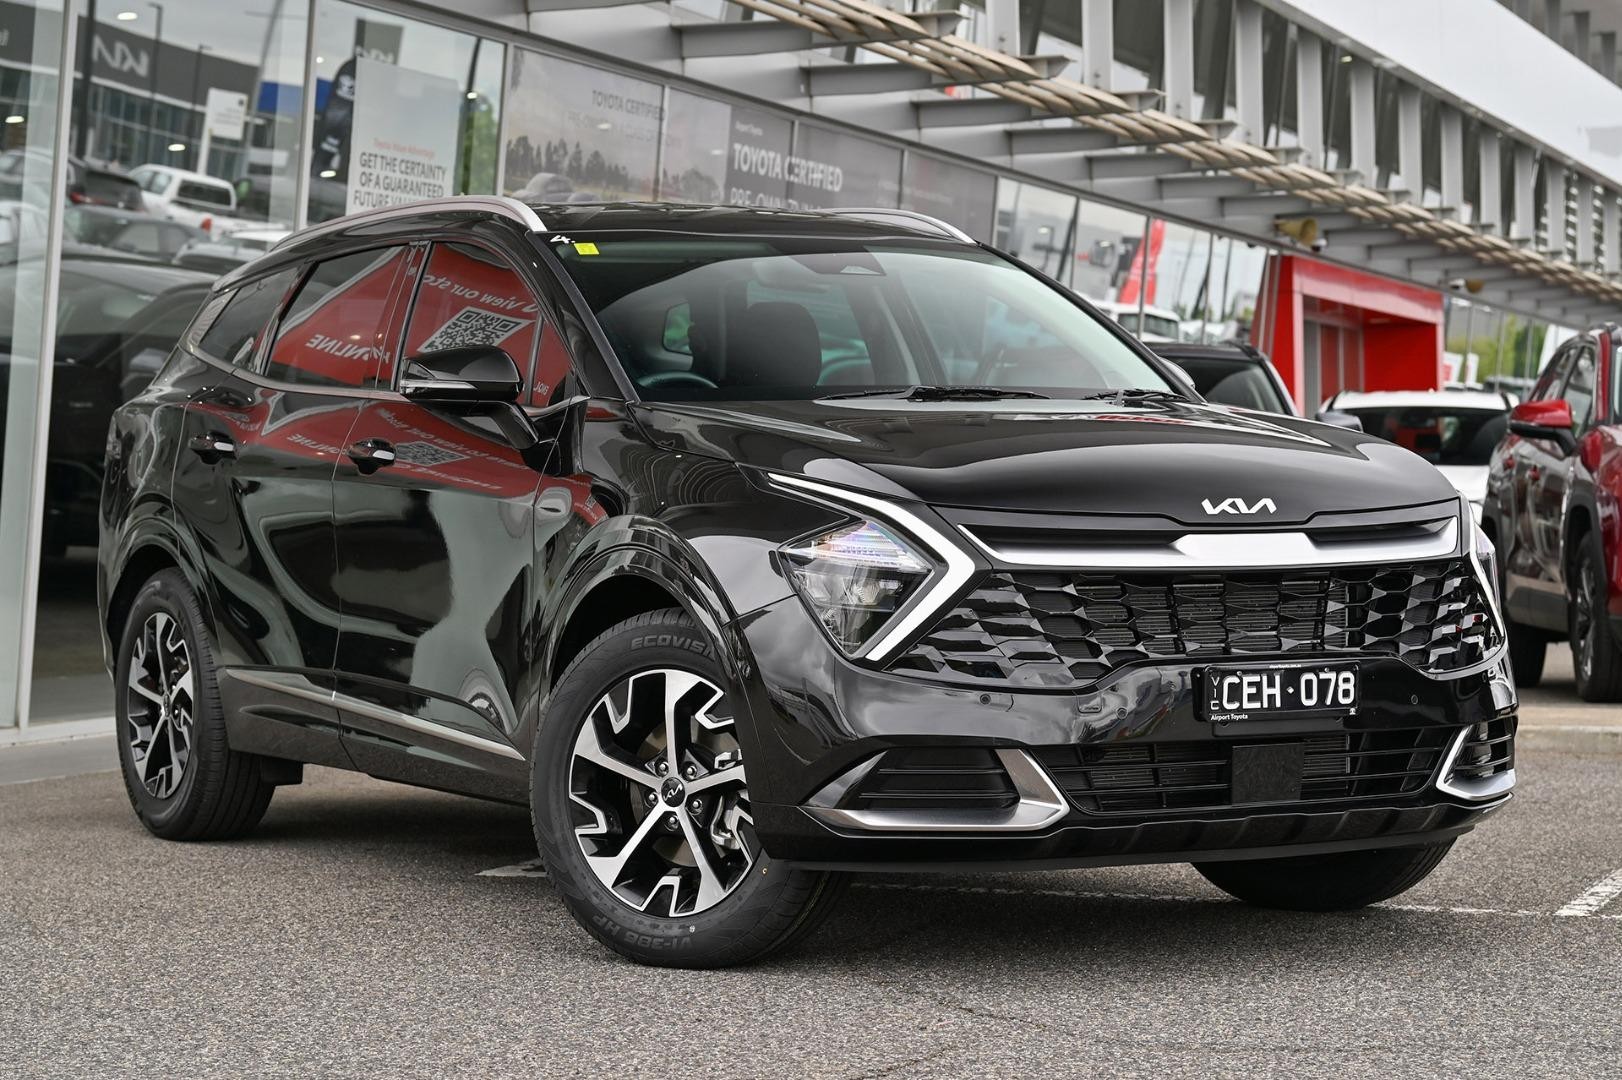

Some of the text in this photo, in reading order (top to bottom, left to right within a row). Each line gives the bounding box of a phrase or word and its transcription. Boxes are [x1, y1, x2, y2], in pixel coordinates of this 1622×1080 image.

[592, 89, 623, 112] TOYOTA
[360, 152, 447, 183] GET THE CERTAINTY
[734, 142, 843, 192] TOYOTA CERTIFIED
[360, 171, 445, 199] OF A GUARANTEED
[1201, 497, 1277, 515] KIA
[1222, 671, 1356, 710] CEH 078
[1230, 713, 1249, 721] Toyota
